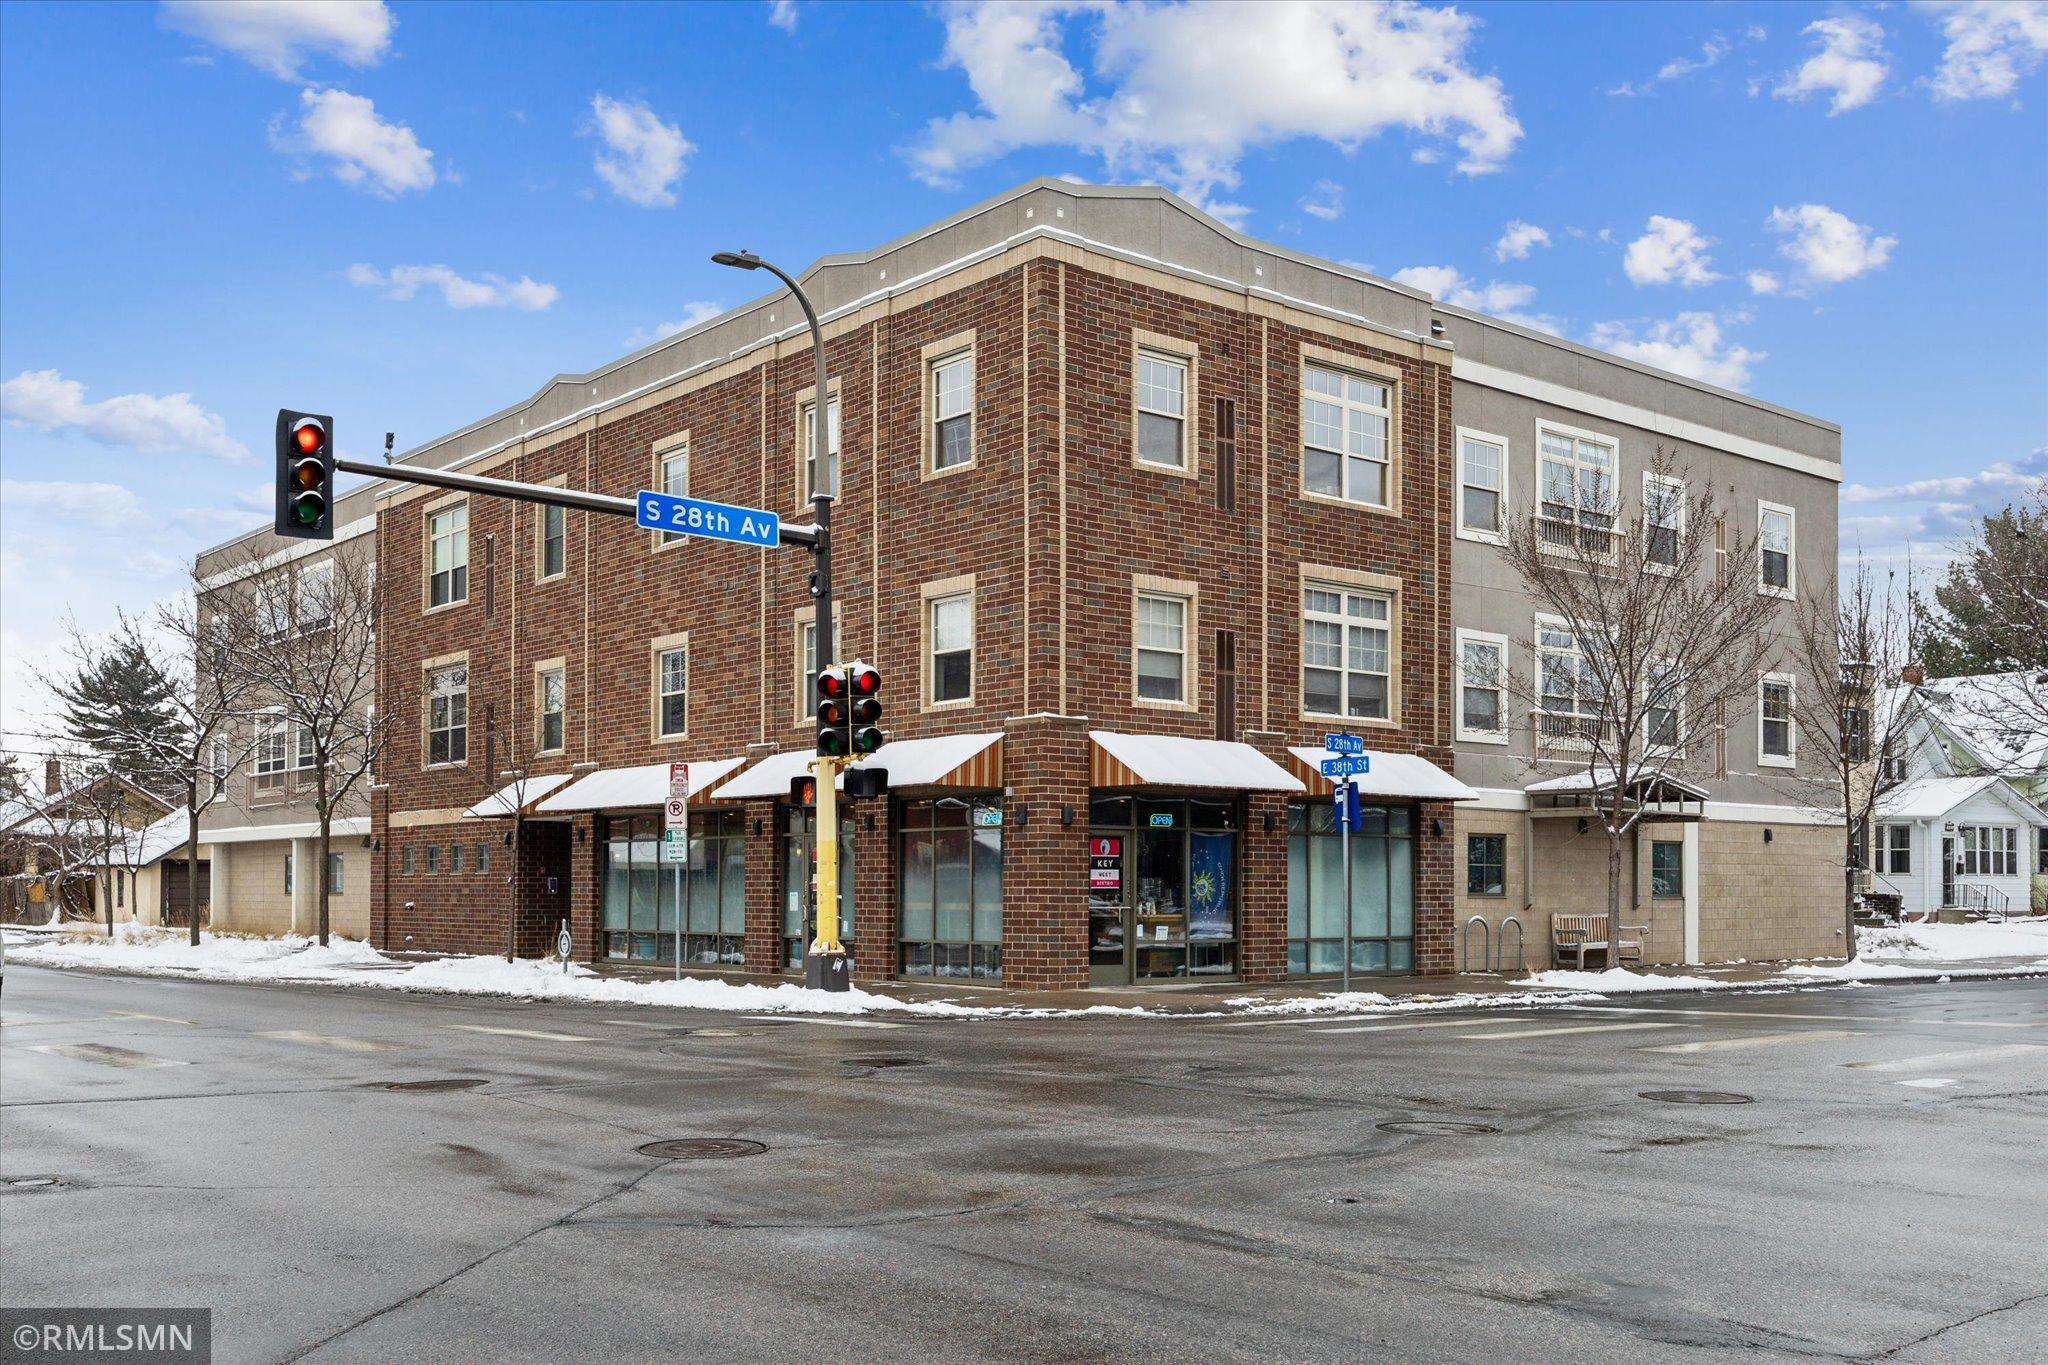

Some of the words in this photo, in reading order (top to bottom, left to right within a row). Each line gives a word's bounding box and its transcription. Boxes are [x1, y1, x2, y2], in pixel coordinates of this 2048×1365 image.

[645, 500, 661, 521] S
[671, 504, 730, 533] 28th
[740, 516, 771, 539] Av
[1327, 737, 1332, 749] S
[1334, 738, 1351, 750] 28th
[1353, 740, 1362, 751] Av
[1322, 762, 1328, 774] E
[1331, 761, 1353, 773] 38th
[1356, 759, 1367, 771] St
[984, 814, 1001, 823] OPEN
[1151, 816, 1172, 825] OPEN
[1097, 859, 1114, 868] KEY
